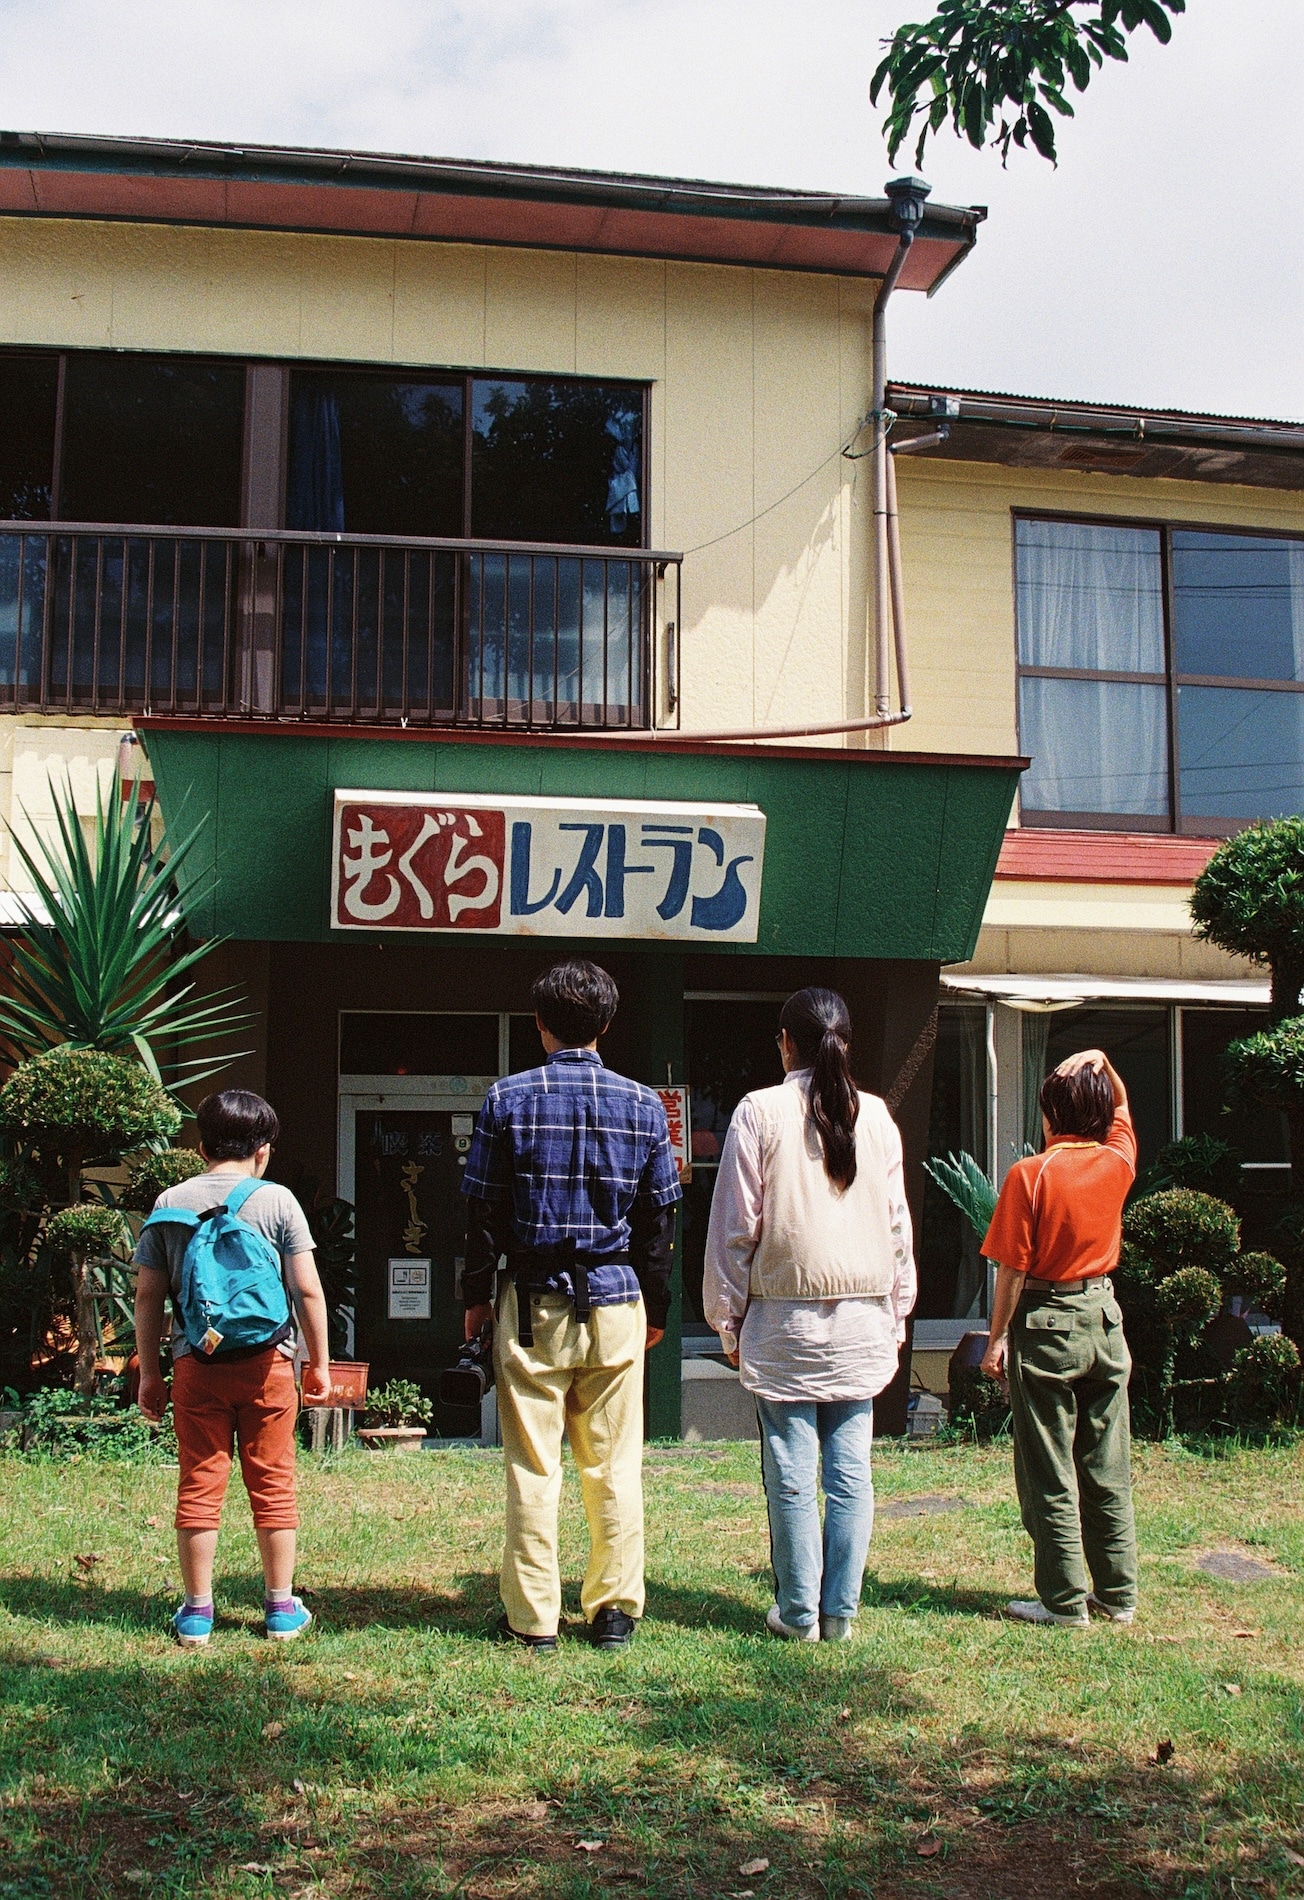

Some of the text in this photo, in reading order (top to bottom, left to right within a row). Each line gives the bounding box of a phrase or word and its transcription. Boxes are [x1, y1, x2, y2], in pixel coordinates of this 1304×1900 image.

[342, 812, 754, 931] もぐら レストラン
[381, 1131, 442, 1156] 喫茶
